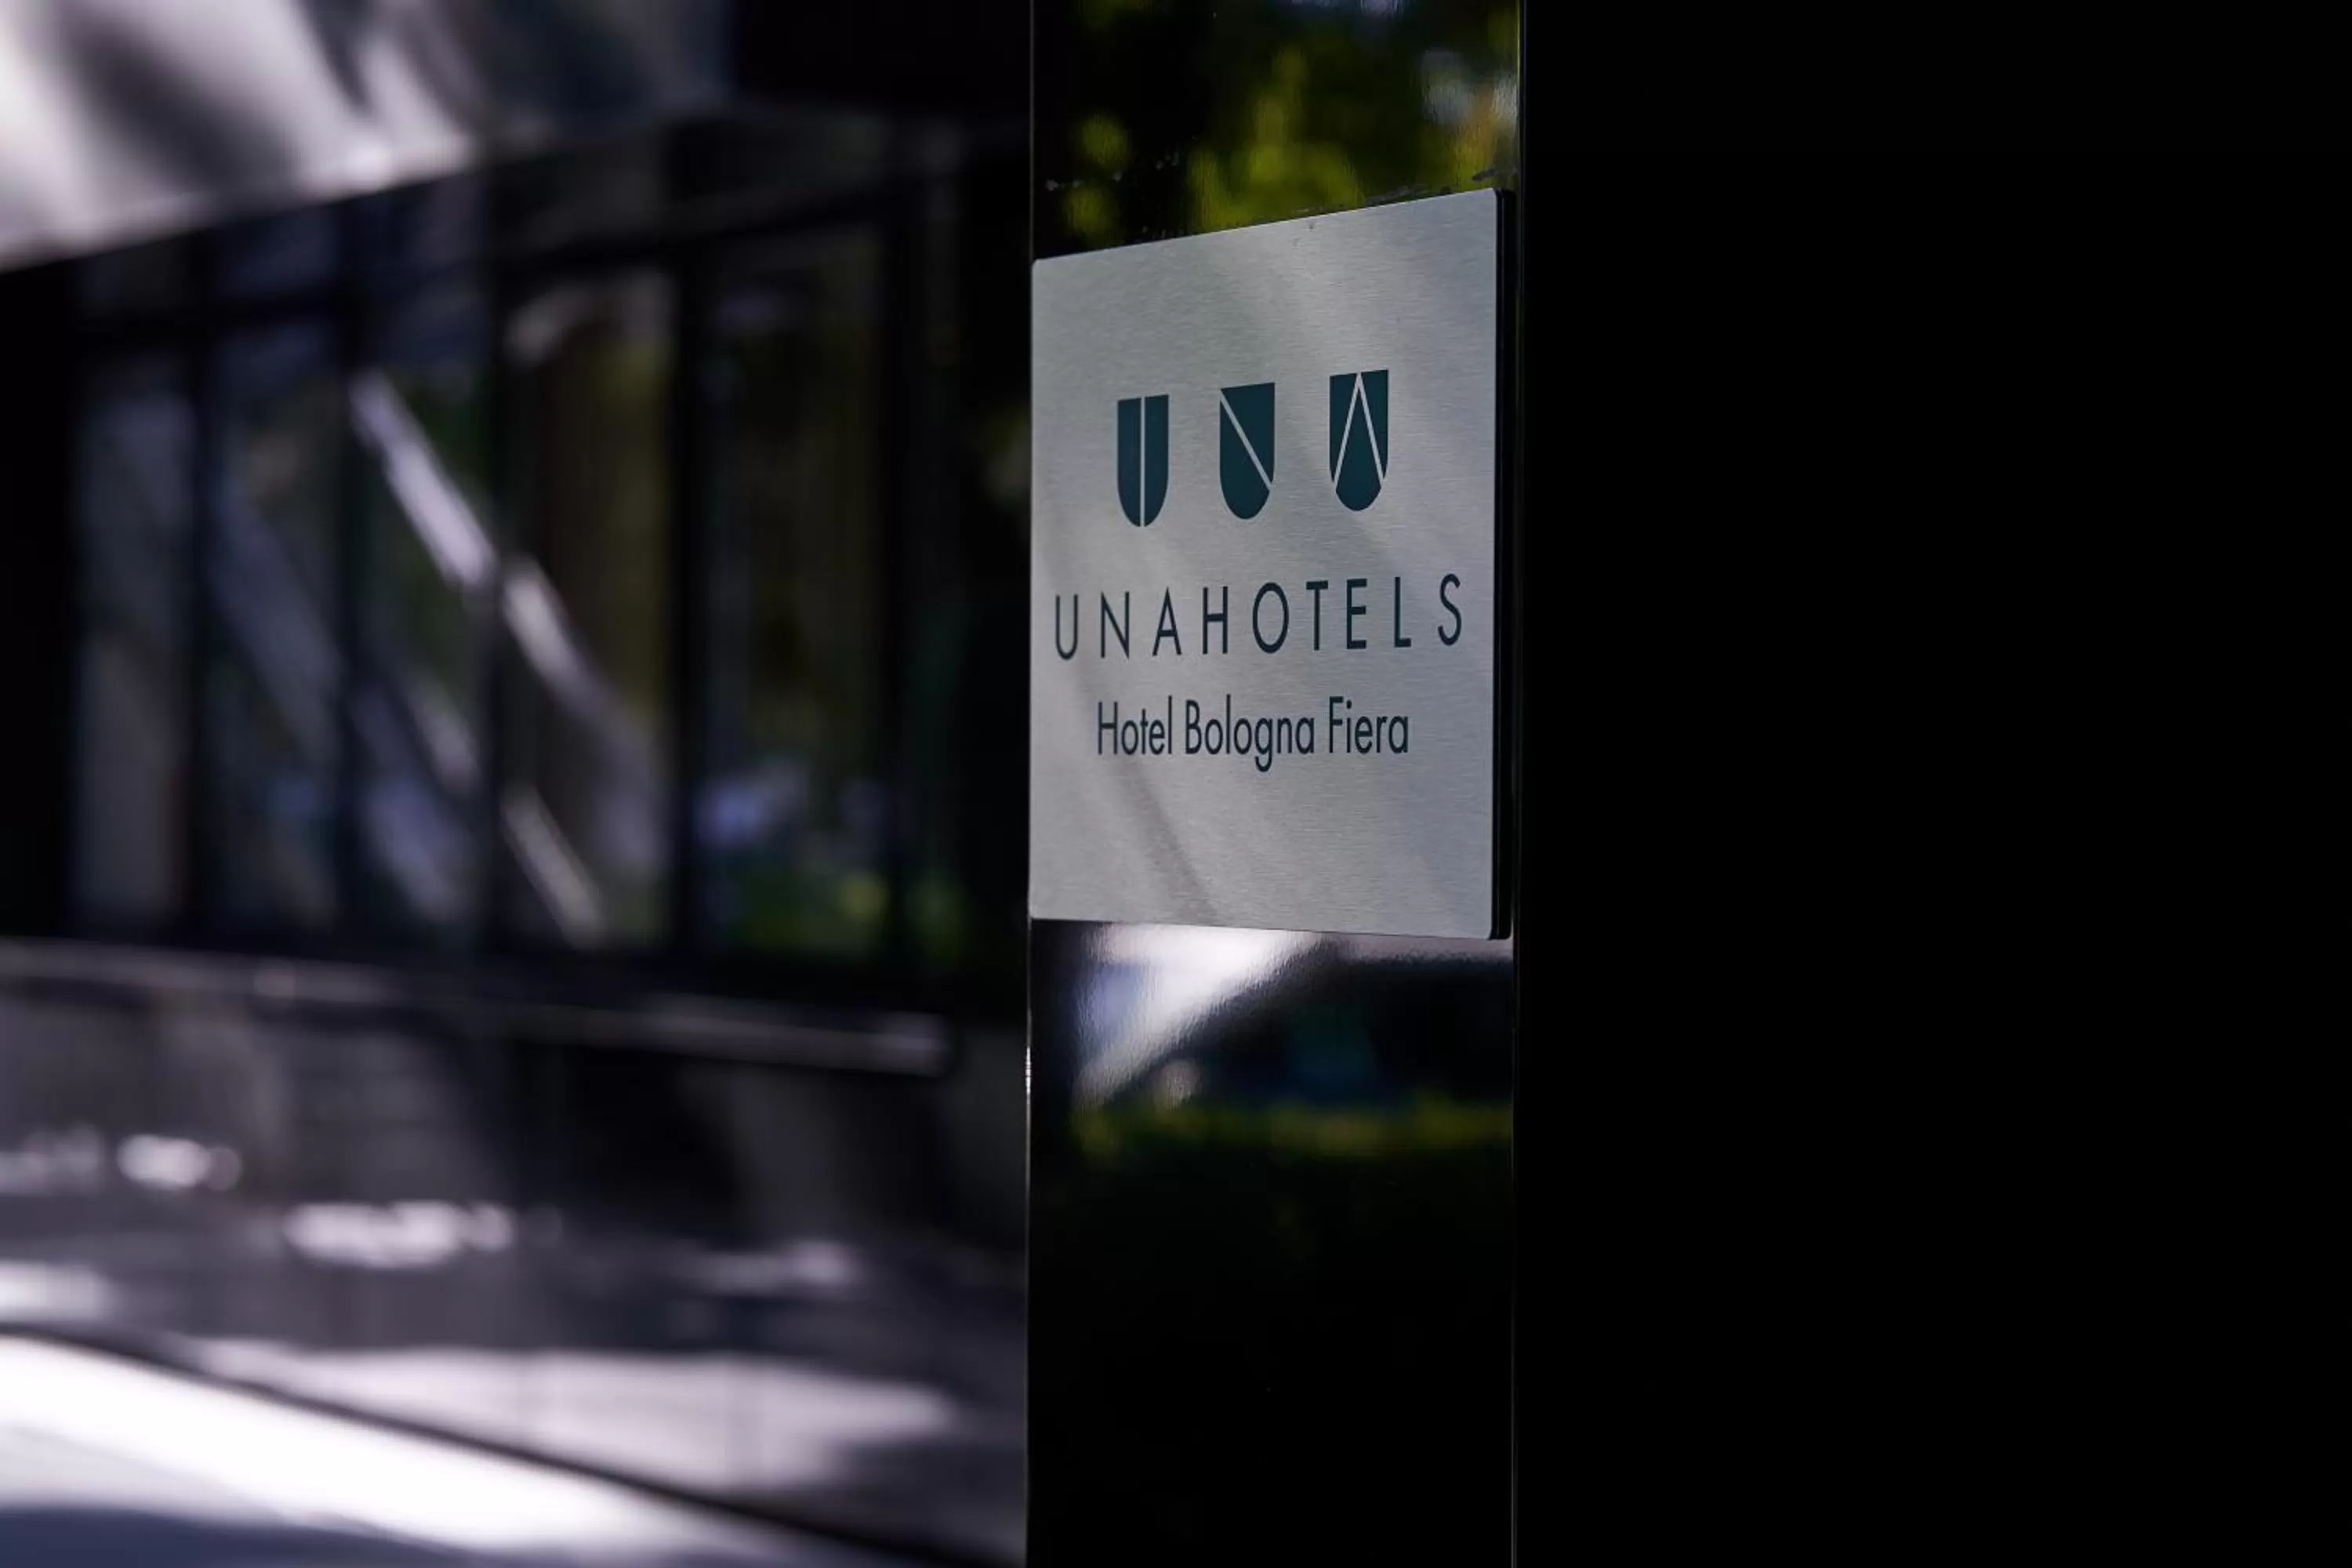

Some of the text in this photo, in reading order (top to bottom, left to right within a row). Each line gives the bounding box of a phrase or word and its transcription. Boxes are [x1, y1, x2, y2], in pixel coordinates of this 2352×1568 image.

[1054, 573, 1463, 661] UNAHOTELS
[1098, 693, 1410, 773] Hotel Bologna Fiera
